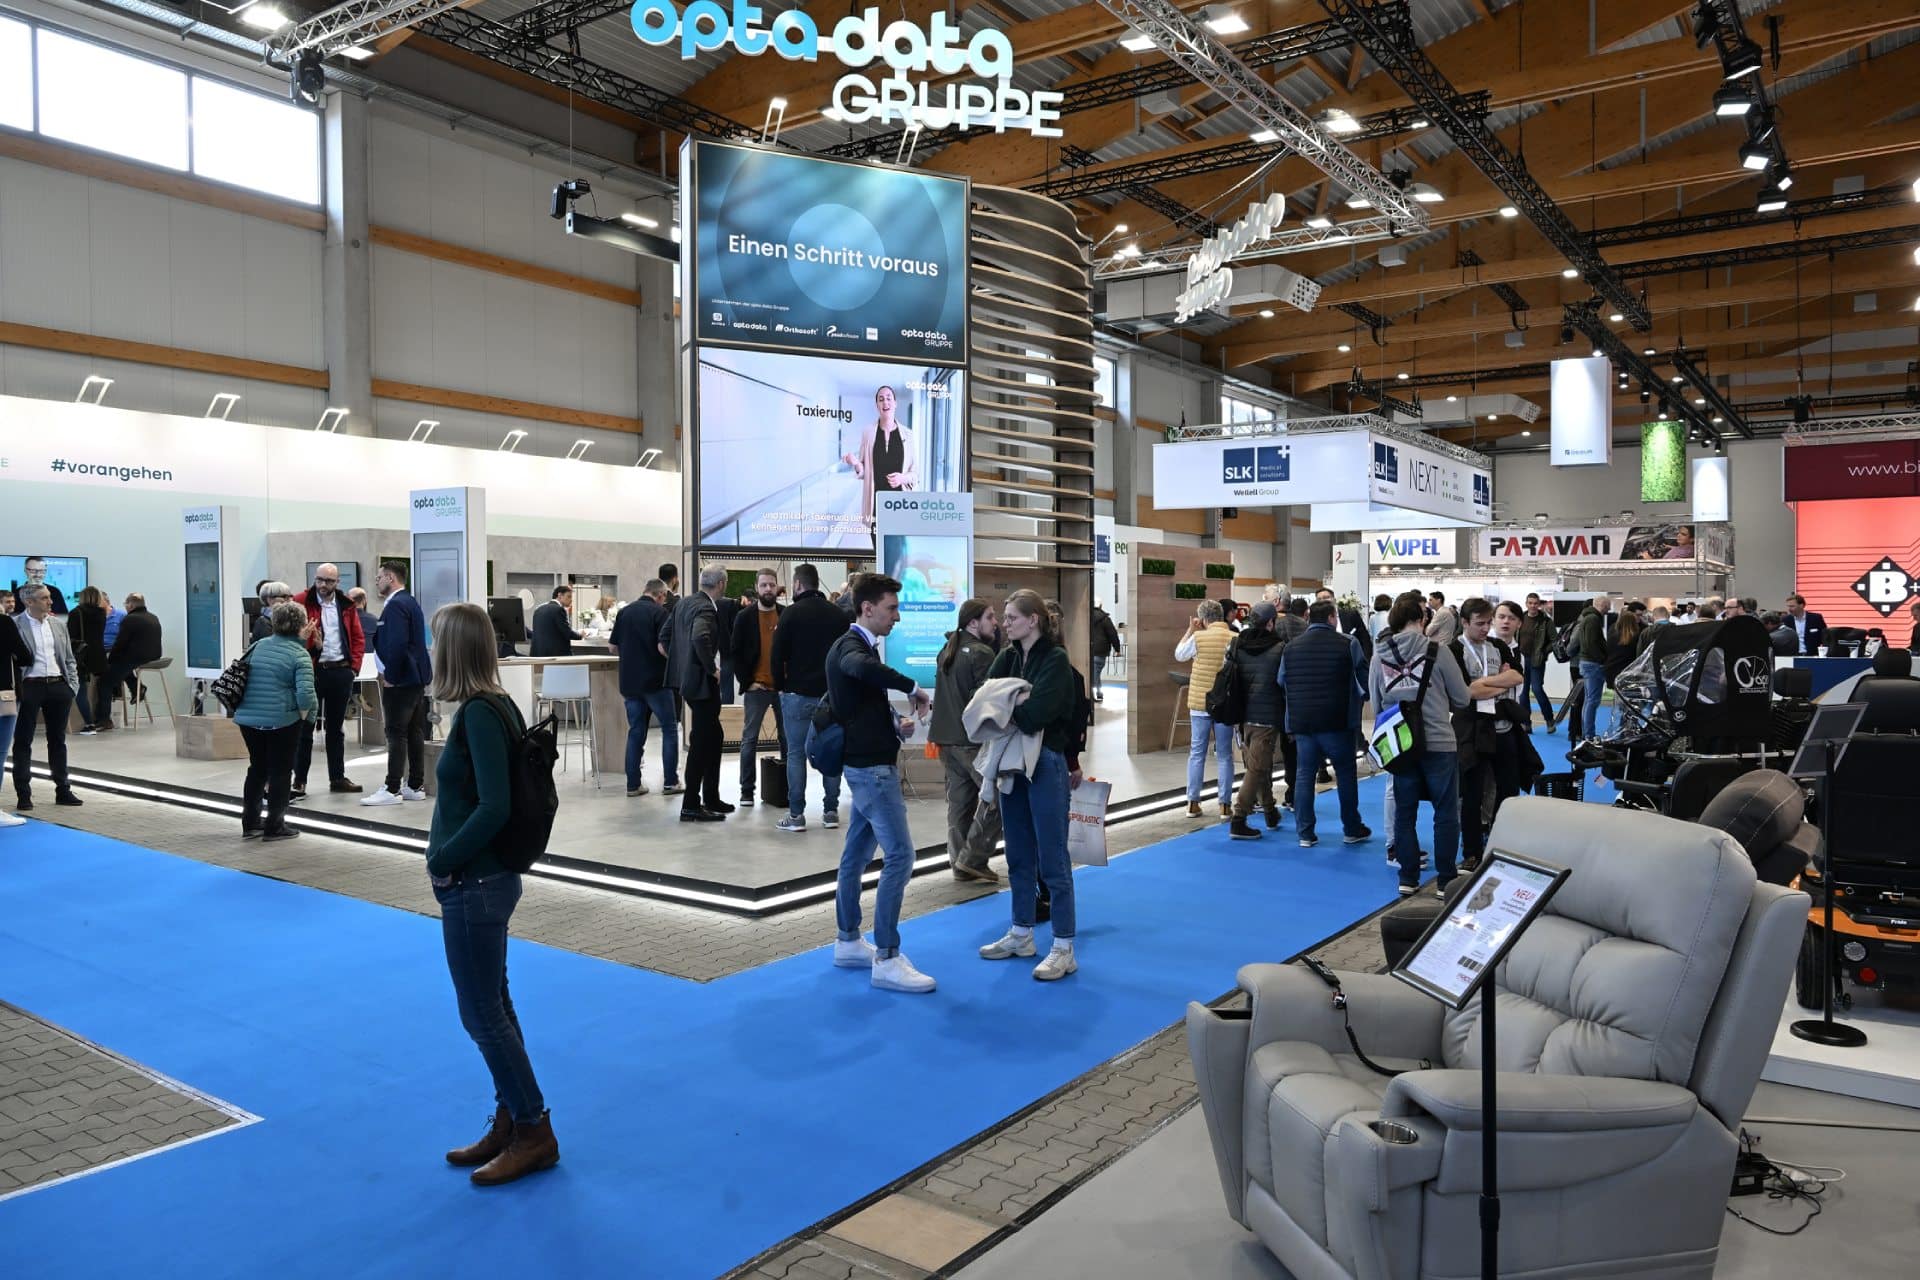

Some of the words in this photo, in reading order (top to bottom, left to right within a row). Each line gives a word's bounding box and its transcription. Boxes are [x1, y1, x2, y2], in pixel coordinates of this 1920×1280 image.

[630, 0, 817, 62] opta
[832, 7, 1013, 79] data
[833, 74, 1064, 137] GRUPPE
[729, 233, 788, 260] Einen
[794, 242, 864, 270] Schritt
[868, 255, 939, 278] voraus
[901, 329, 924, 338] opta
[925, 331, 947, 341] data
[925, 339, 953, 349] GRUPPE
[796, 404, 853, 423] Taxierung
[51, 458, 173, 482] #vorangehen
[1225, 466, 1253, 480] SLK
[1409, 458, 1439, 496] NEXT
[1259, 488, 1279, 497] Group
[414, 495, 434, 510] opta
[435, 495, 456, 507] data
[884, 498, 919, 511] opta
[920, 498, 955, 511] data
[920, 512, 965, 522] GRUPPE
[1376, 534, 1441, 560] VAUPEL
[1490, 535, 1611, 557] PARAVAN
